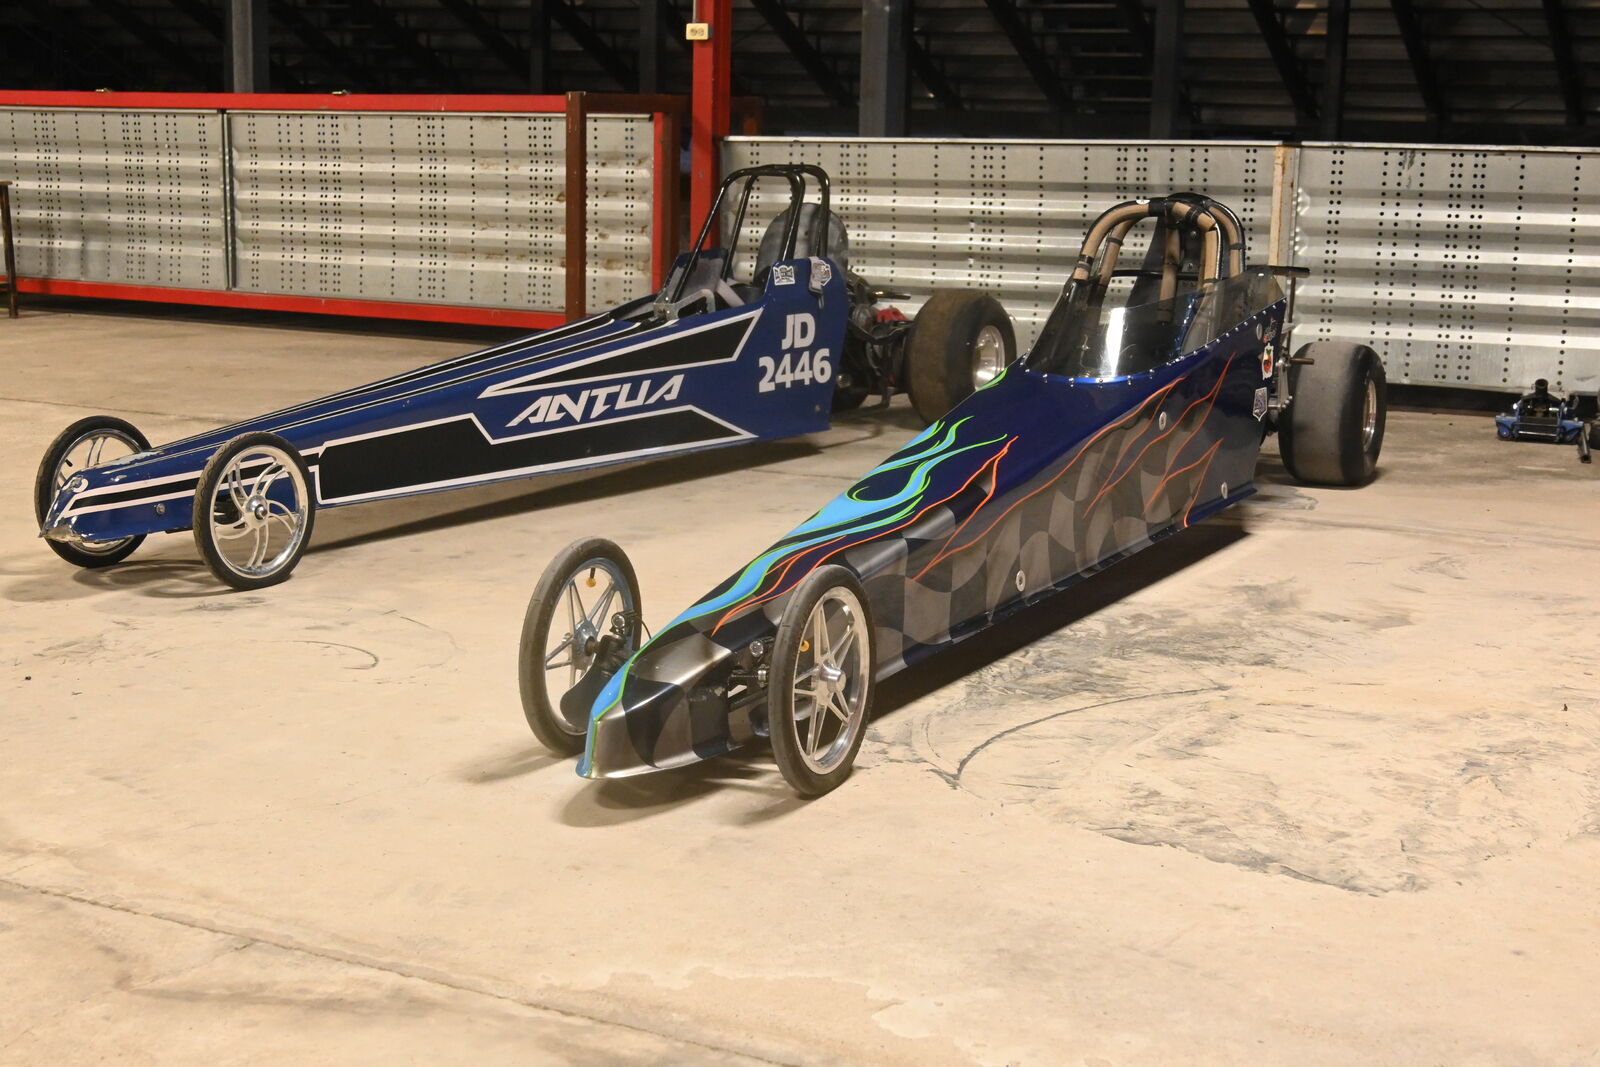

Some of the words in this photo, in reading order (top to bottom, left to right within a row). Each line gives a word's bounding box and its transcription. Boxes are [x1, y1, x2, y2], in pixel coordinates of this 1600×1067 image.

[782, 313, 816, 350] JD
[758, 348, 832, 393] 2446
[505, 374, 685, 428] ANTUA
